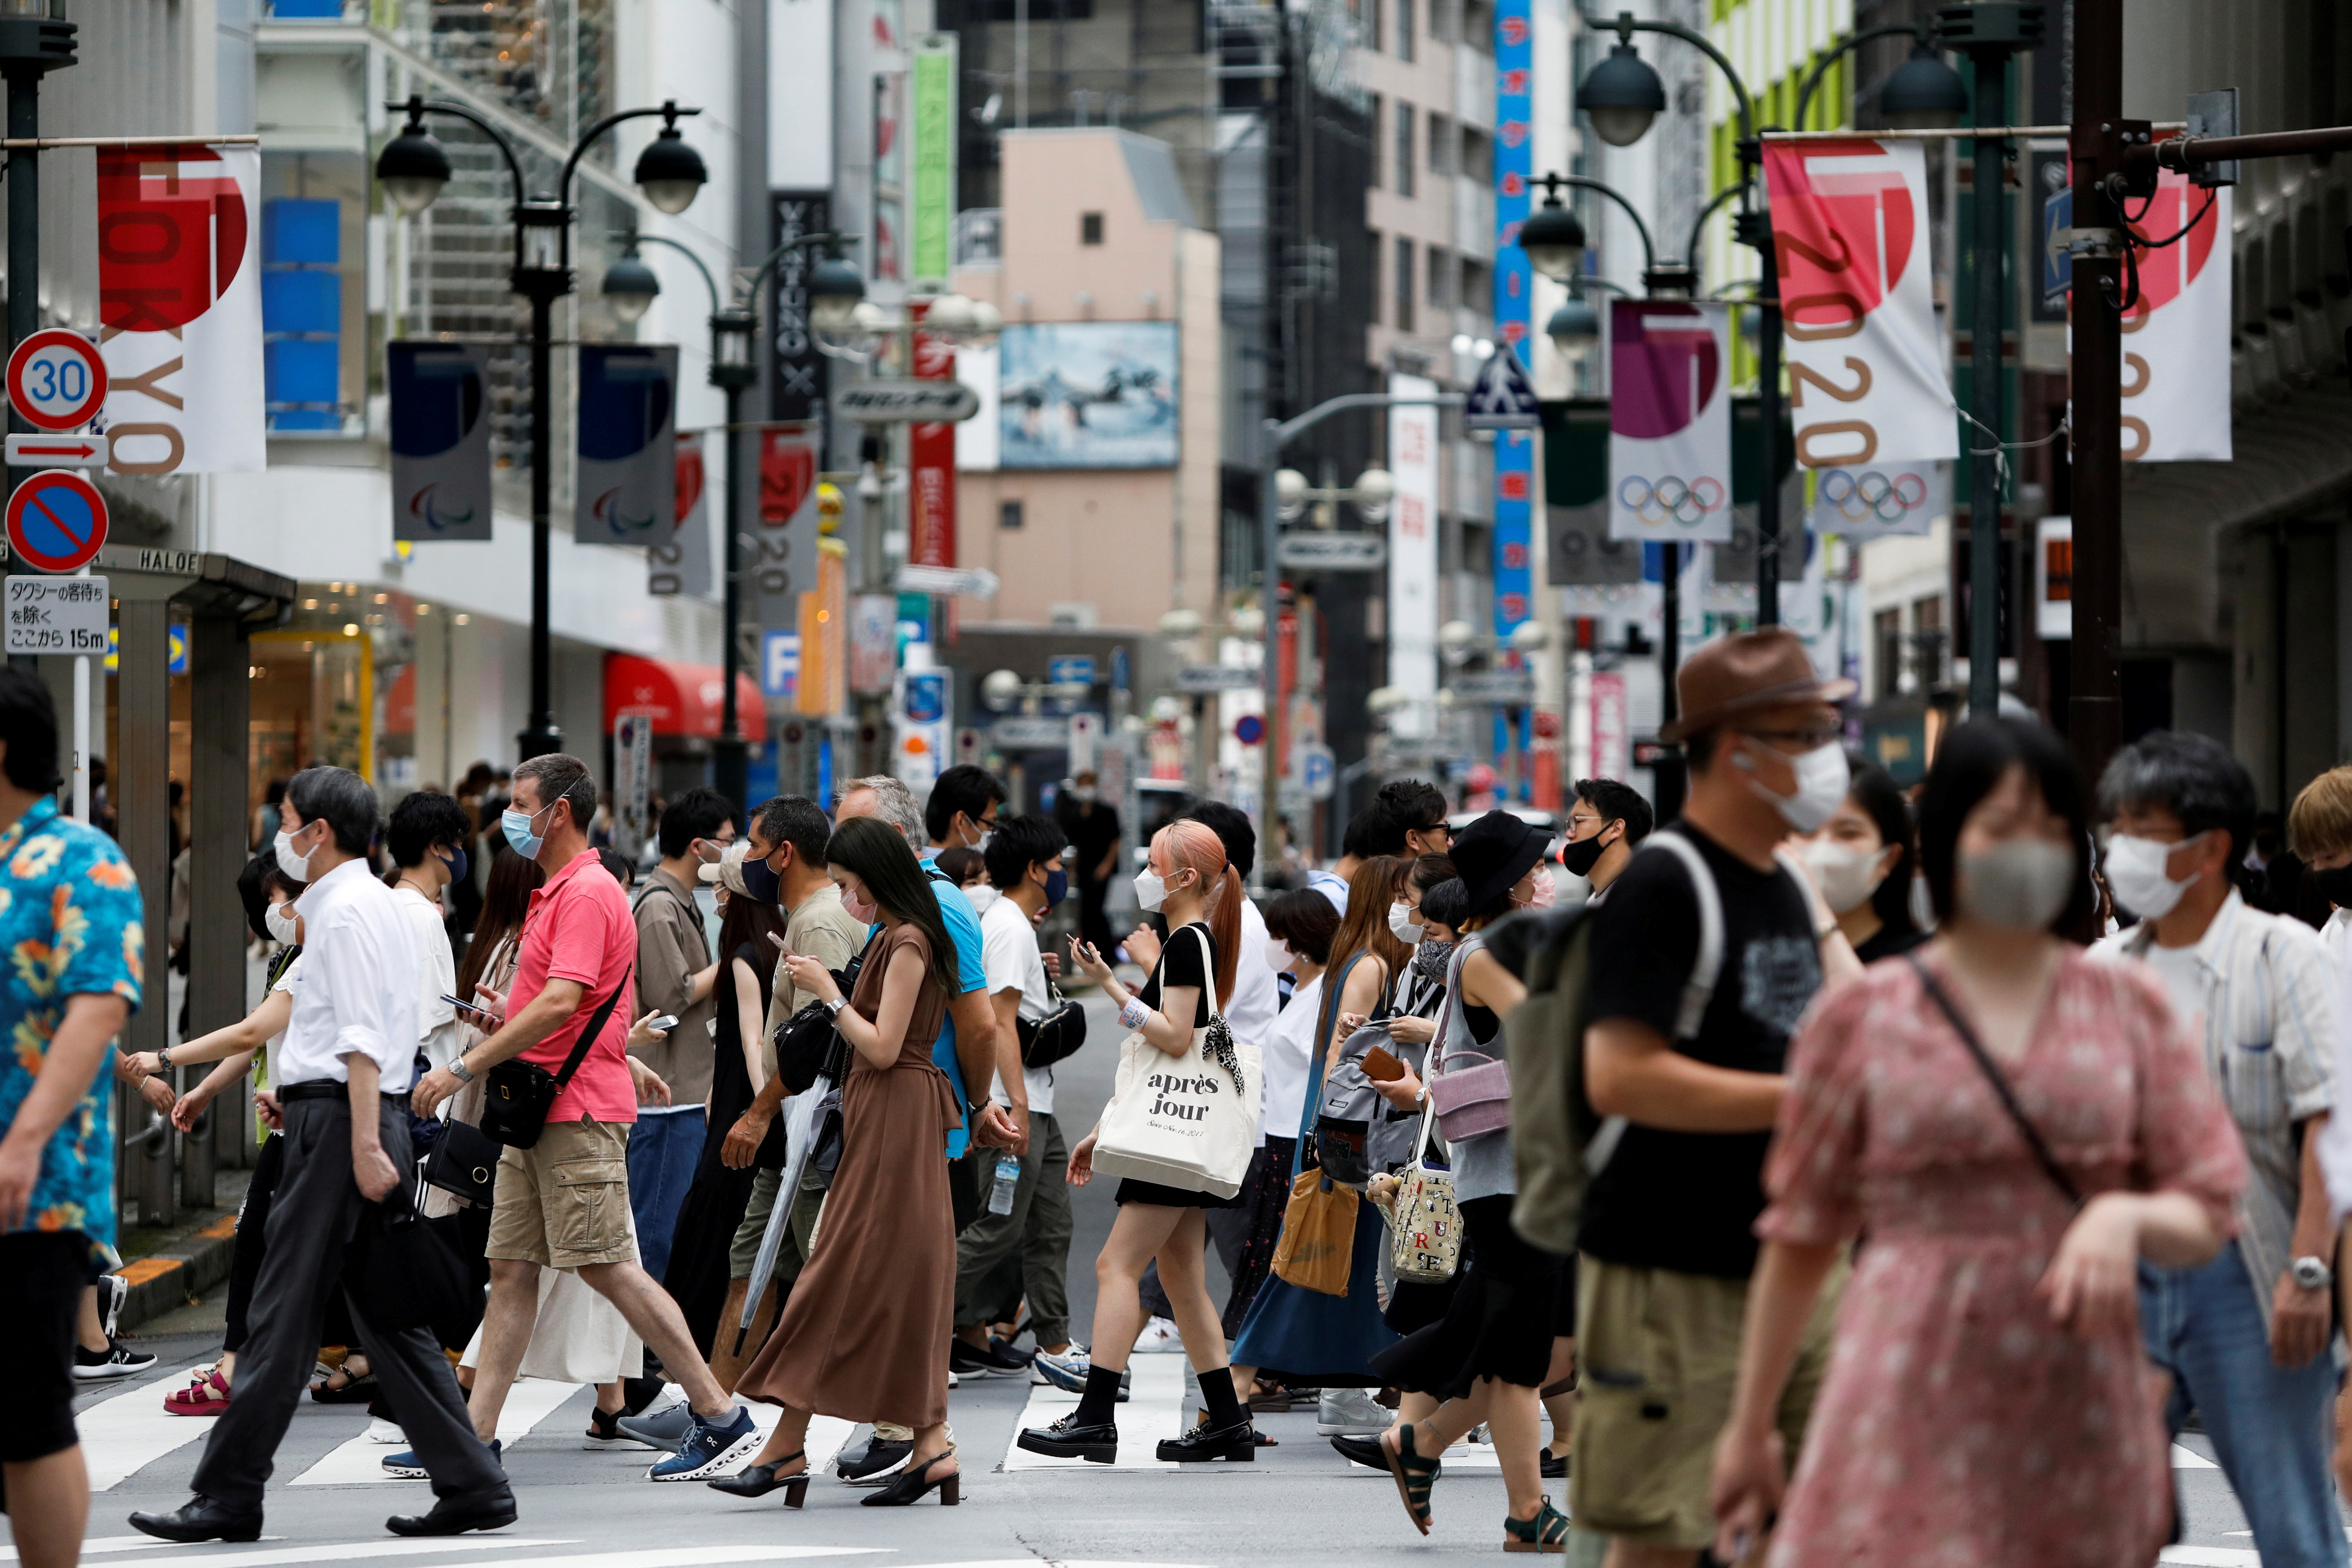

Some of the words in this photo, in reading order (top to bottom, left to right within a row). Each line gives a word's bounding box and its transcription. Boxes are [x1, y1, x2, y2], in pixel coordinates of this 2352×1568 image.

[1776, 228, 1877, 468] 2020
[32, 360, 86, 402] 30
[10, 582, 103, 602] タクシーの客待ち
[11, 605, 51, 624] を除く
[12, 629, 64, 648] ここから
[71, 628, 103, 647] 15m
[1147, 1073, 1218, 1095] après
[1149, 1093, 1209, 1121] jour
[1147, 1119, 1162, 1128] Since
[1414, 1232, 1430, 1249] R
